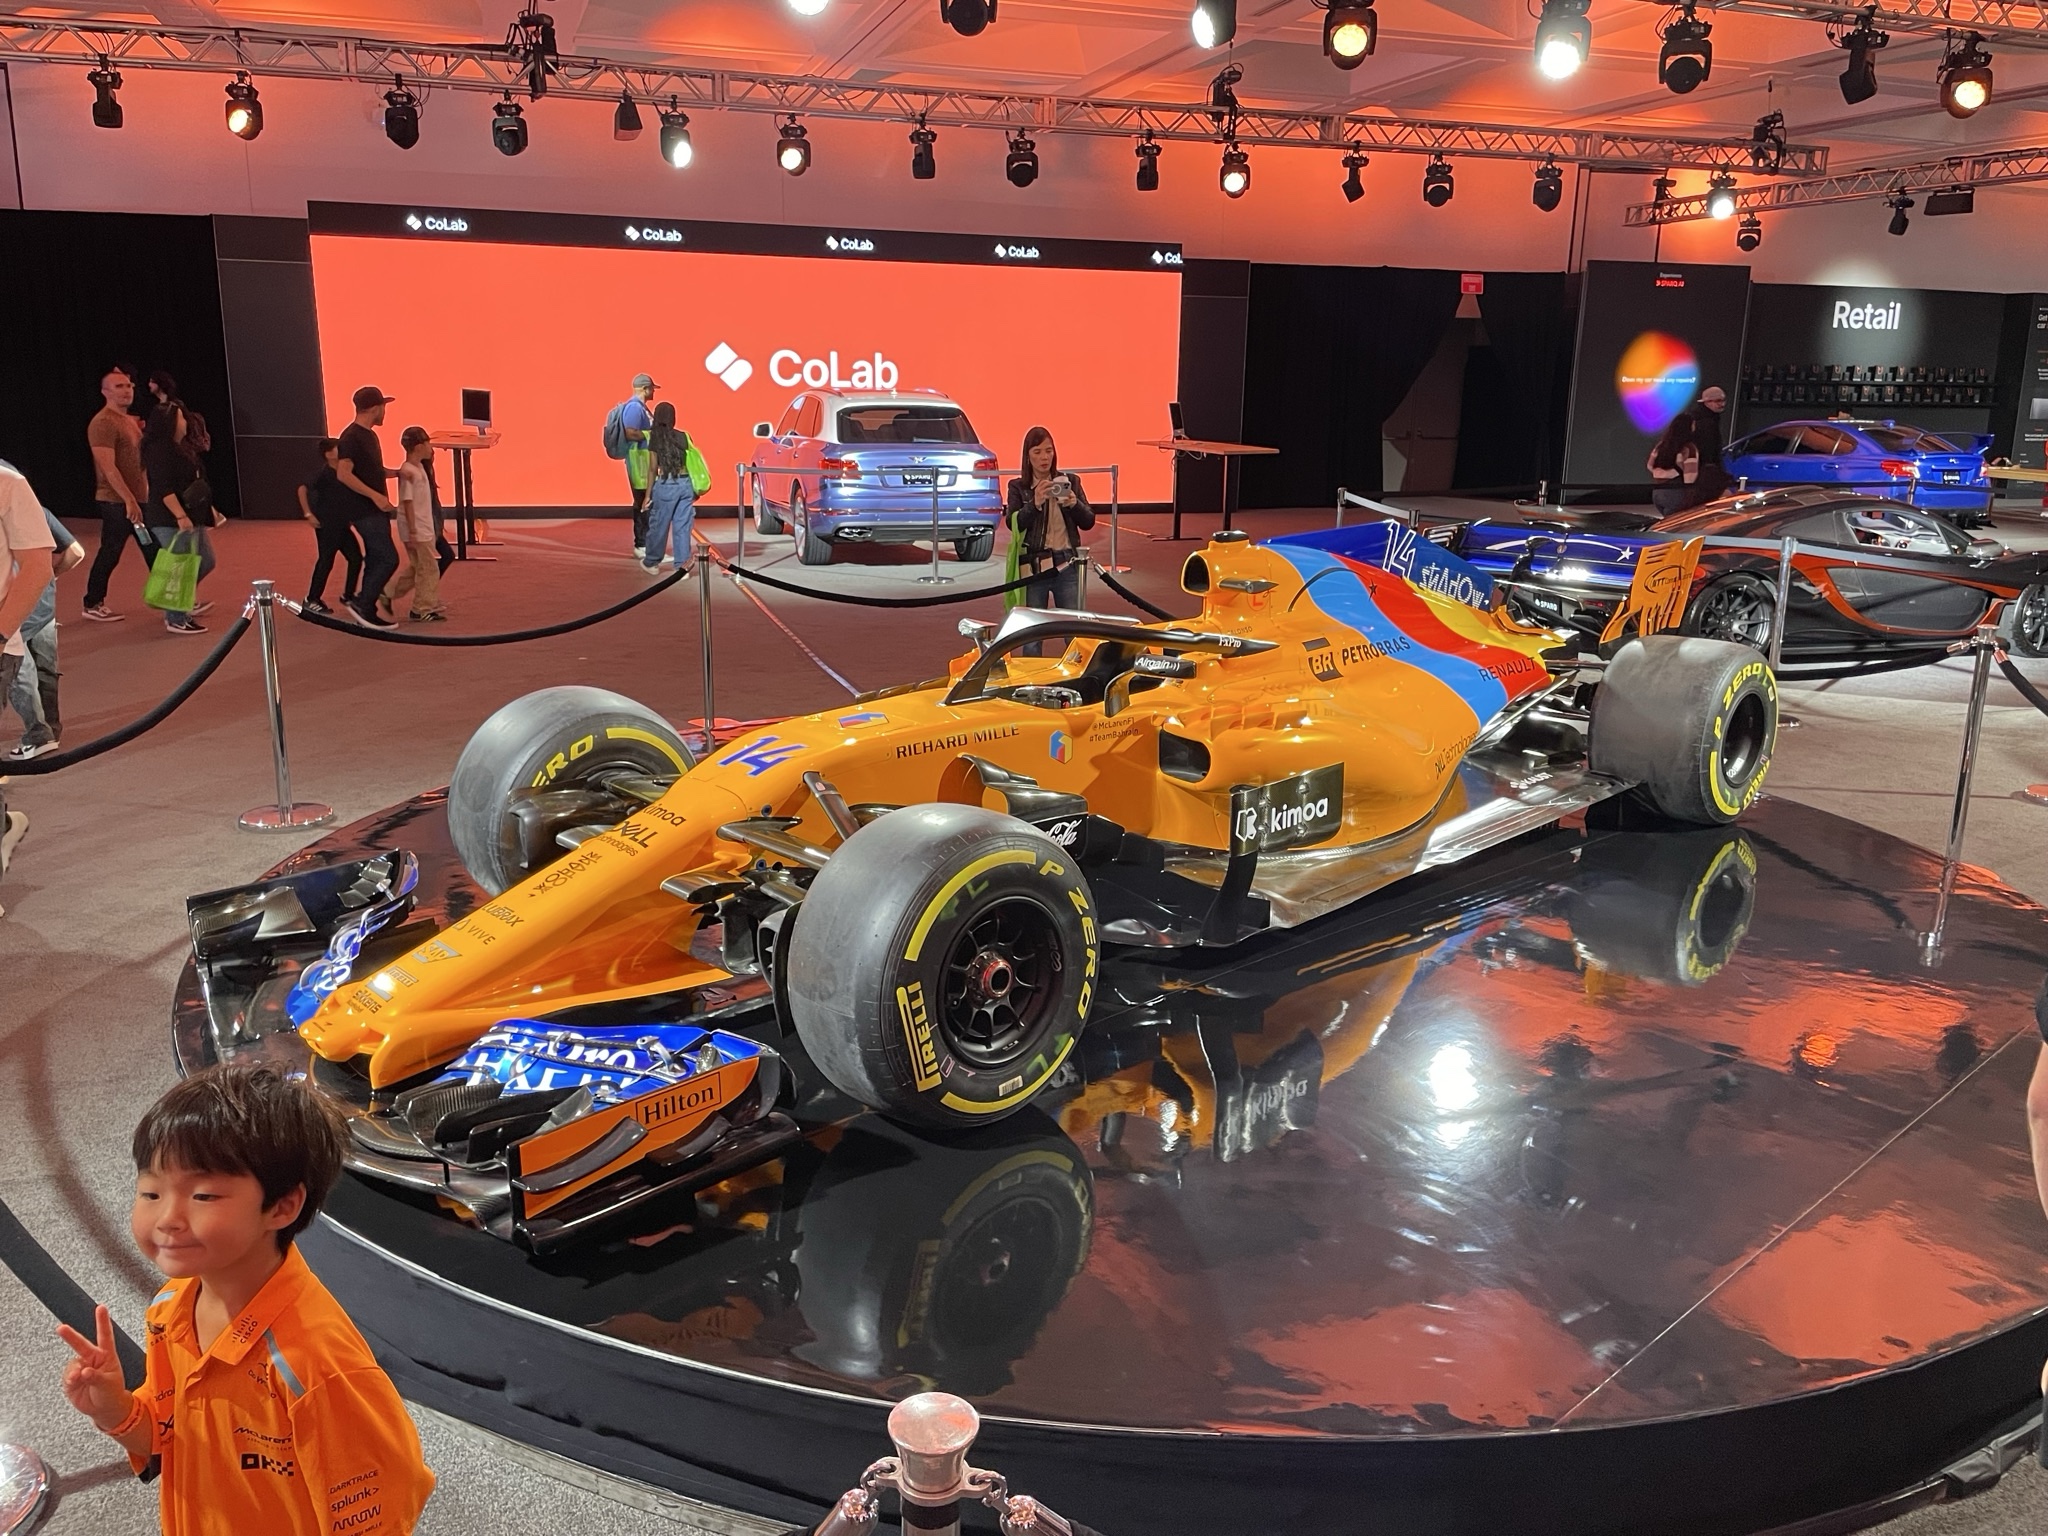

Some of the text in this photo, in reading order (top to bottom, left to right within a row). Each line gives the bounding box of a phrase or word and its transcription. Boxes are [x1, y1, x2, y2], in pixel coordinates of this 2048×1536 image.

[425, 216, 468, 233] CoLab
[642, 228, 682, 242] CoLab
[840, 237, 874, 252] CoLab
[1008, 245, 1040, 259] CoLab
[1164, 252, 1184, 264] CoL
[1832, 300, 1902, 331] Retail
[769, 347, 898, 391] CoLab
[1382, 519, 1416, 580] 14
[1219, 636, 1242, 648] FxPro
[1341, 636, 1412, 666] PETROBRAS
[1135, 656, 1170, 671] Airgain
[1478, 657, 1537, 682] RENAULT
[1723, 661, 1763, 712] ZERO
[1089, 728, 1140, 743] #TeamBahrain
[1092, 716, 1135, 731] @McLarenF1
[895, 724, 1020, 760] RICHARD MILLE
[716, 735, 810, 777] 14
[1270, 796, 1330, 834] kimoa
[481, 902, 525, 928] LUBRAX
[468, 924, 496, 945] VIVE
[1039, 859, 1098, 1020] P ZERO
[895, 980, 944, 1093] PIRELLI
[643, 1083, 716, 1126] Hilton
[233, 1427, 294, 1444] McLaren
[241, 1453, 295, 1477] OKX
[329, 1469, 379, 1494] DARKTRACE
[332, 1504, 382, 1532] ARROW
